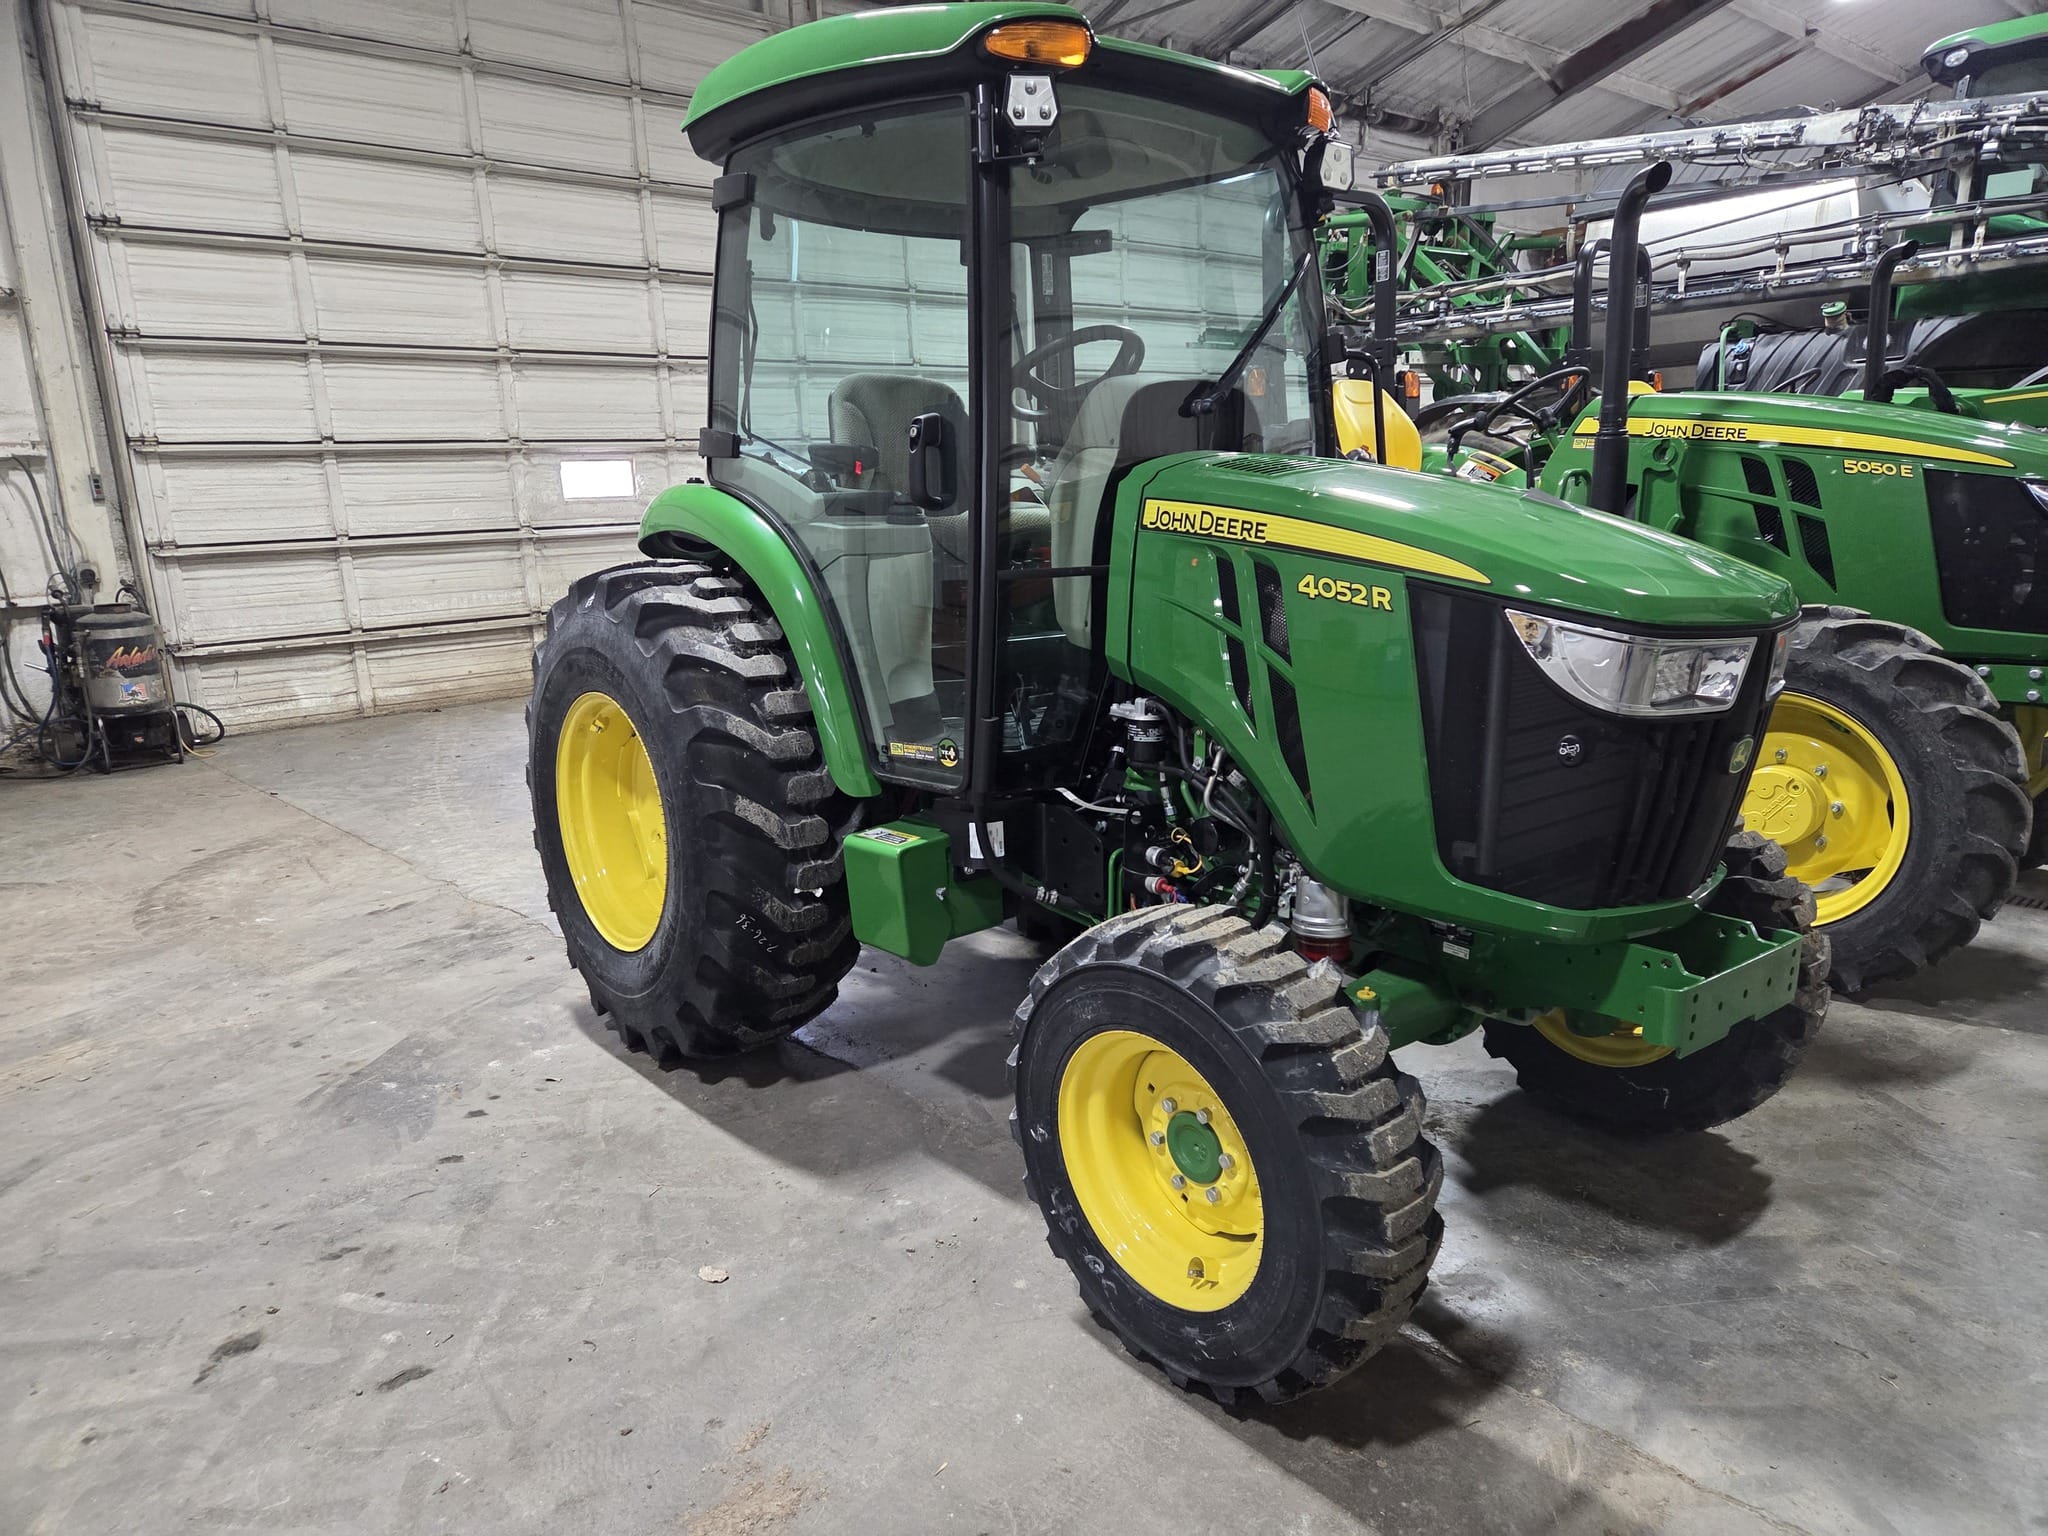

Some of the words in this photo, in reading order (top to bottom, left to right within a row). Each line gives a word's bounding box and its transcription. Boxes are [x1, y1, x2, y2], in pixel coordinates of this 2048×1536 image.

[1645, 422, 1688, 437] JOHN
[1691, 423, 1748, 440] DEERE
[1149, 506, 1197, 530] JOHN
[1199, 510, 1268, 540] DEERE
